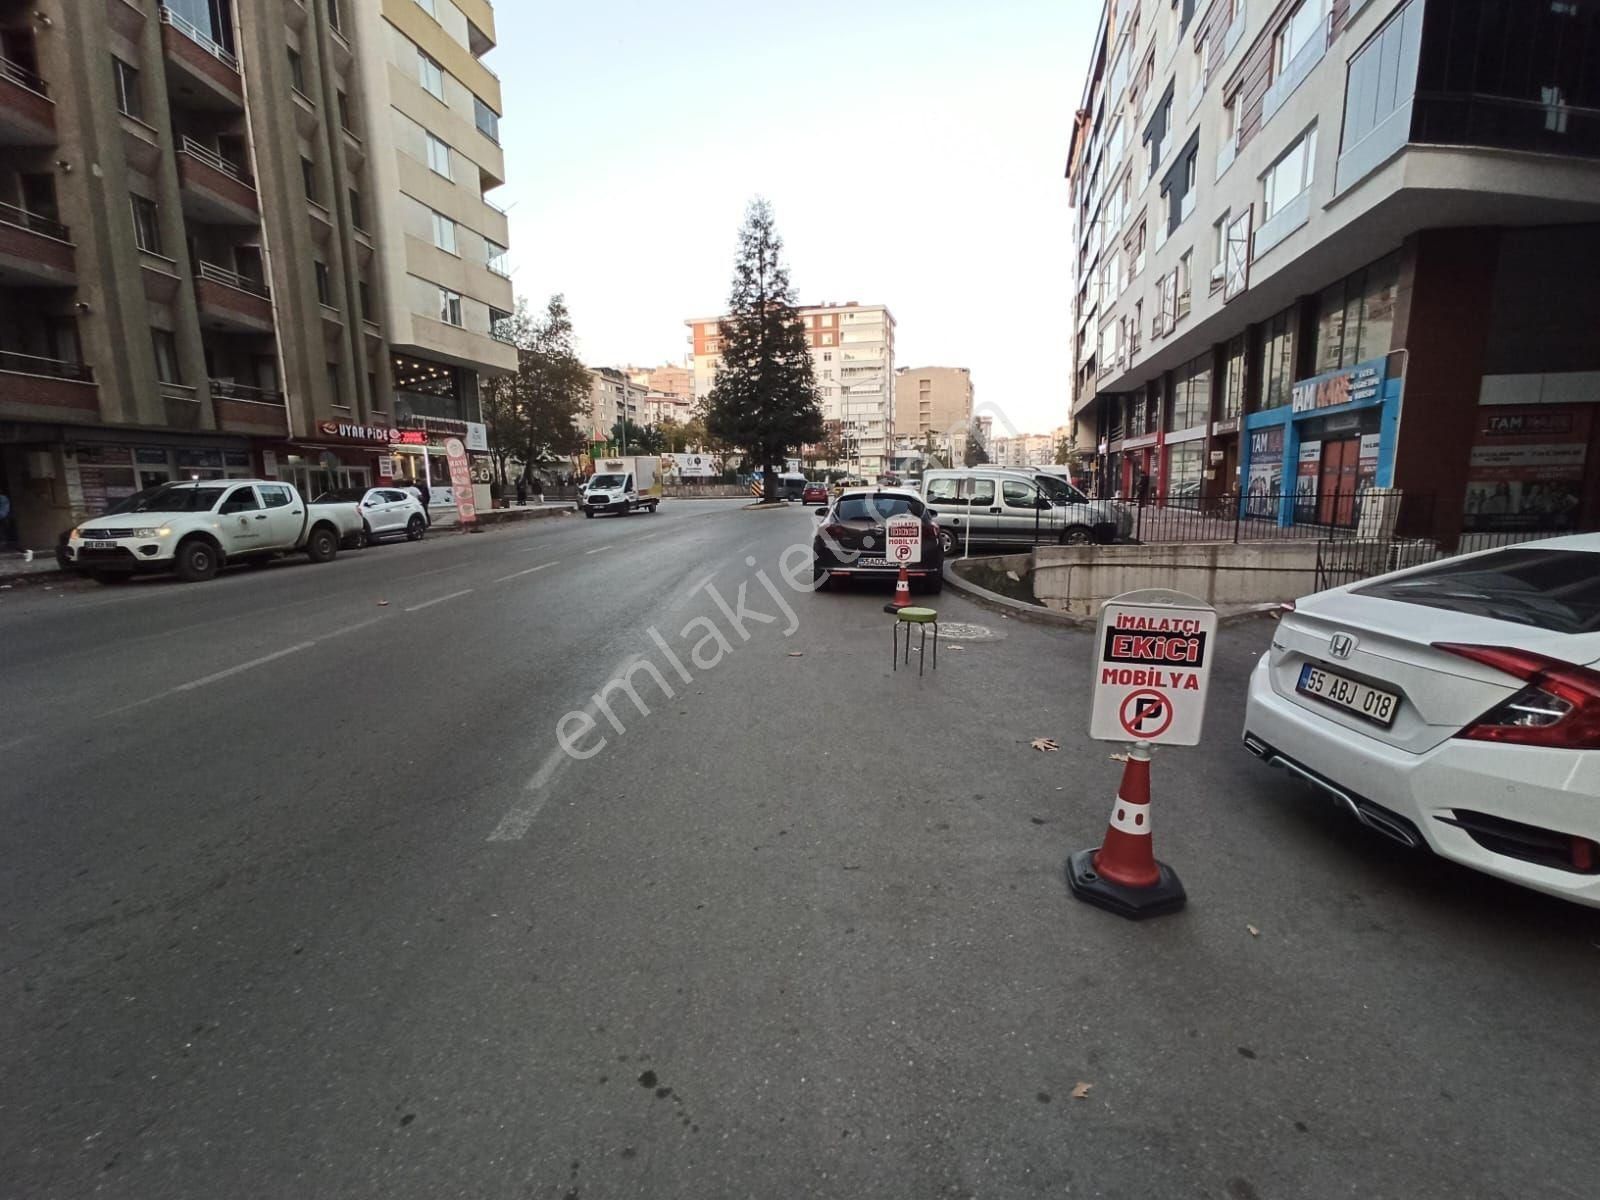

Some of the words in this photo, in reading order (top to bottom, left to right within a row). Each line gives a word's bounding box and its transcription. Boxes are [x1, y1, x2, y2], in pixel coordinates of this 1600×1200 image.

[1292, 383, 1316, 413] TAM
[339, 423, 365, 438] UYAR
[1490, 417, 1522, 430] TAM
[1252, 432, 1268, 453] TAM
[1116, 613, 1200, 636] İMALATÇI
[1102, 667, 1199, 690] MOBİLYA
[1308, 670, 1326, 693] 55
[1328, 679, 1358, 704] ABJ
[1363, 691, 1392, 718] 018
